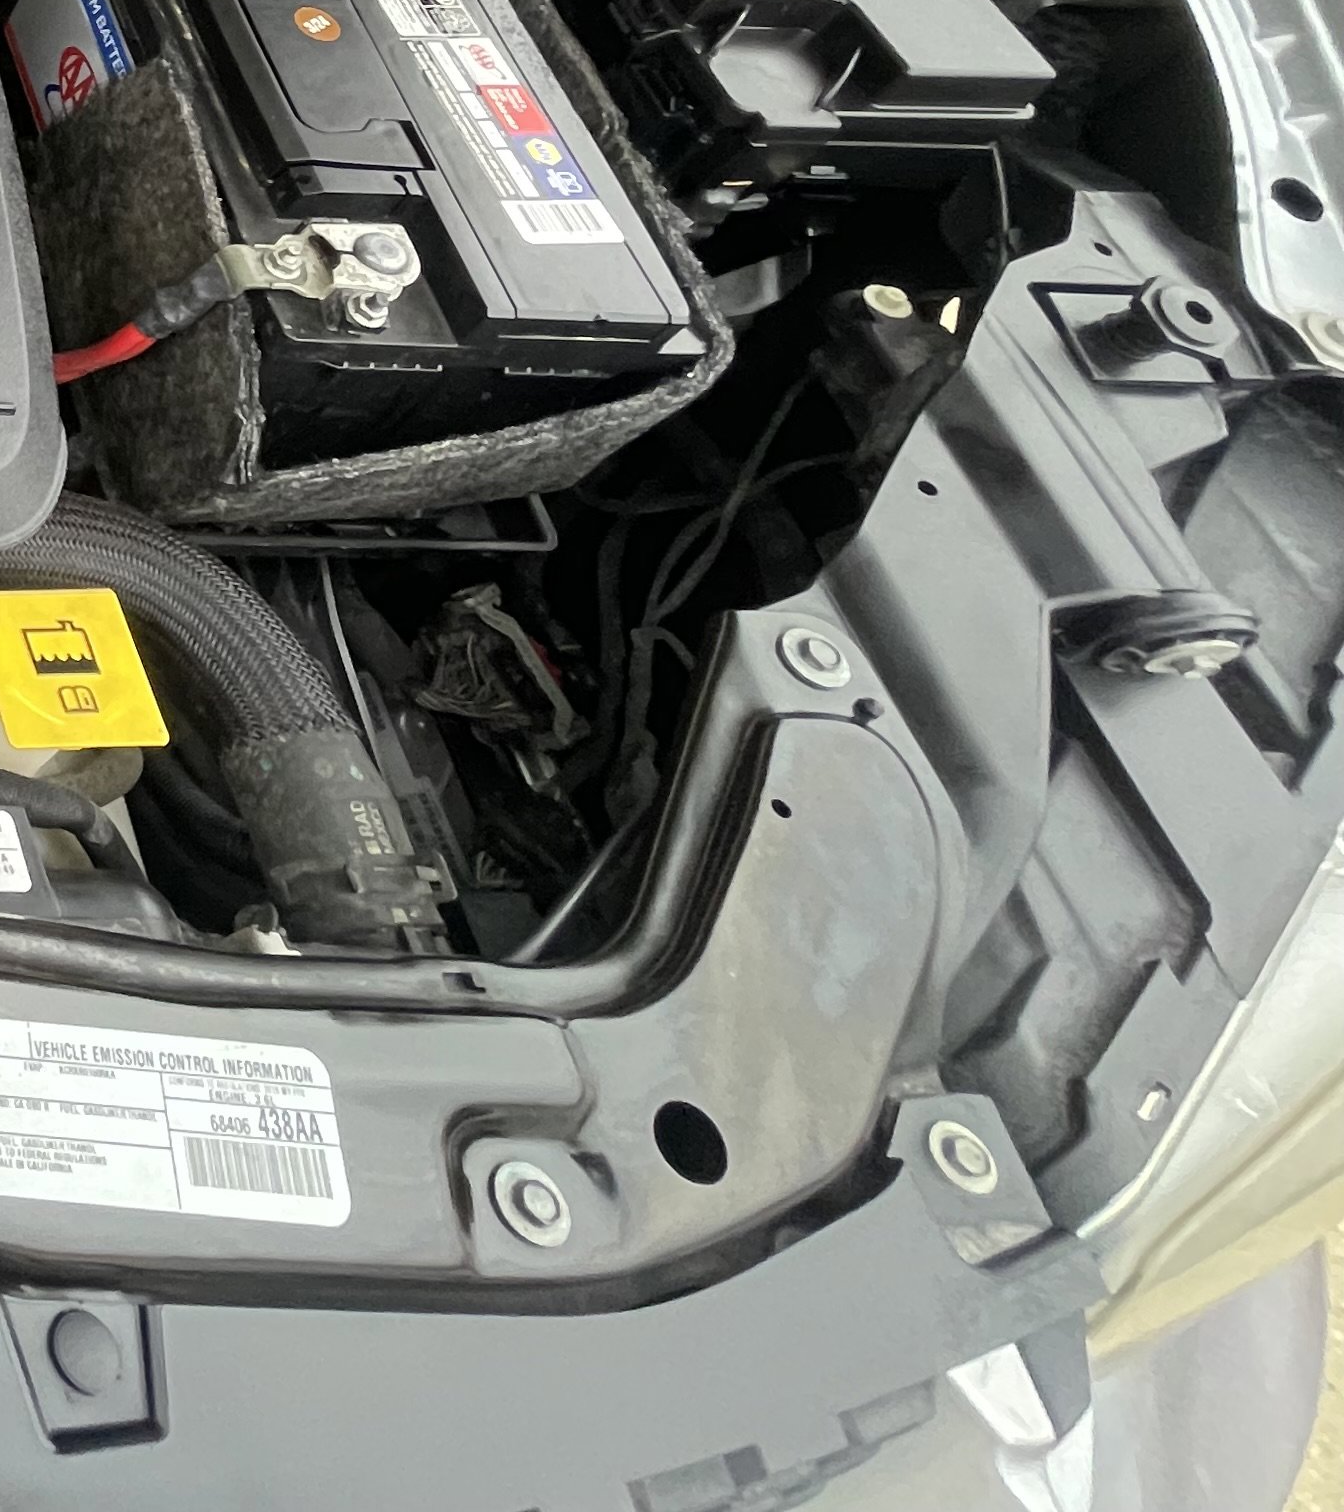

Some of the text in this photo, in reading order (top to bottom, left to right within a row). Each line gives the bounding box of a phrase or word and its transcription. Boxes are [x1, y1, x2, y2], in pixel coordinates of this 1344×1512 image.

[350, 800, 375, 837] RAD
[34, 1040, 314, 1084] VEHICLE EMISSION CONTROL INFORMATION
[210, 1107, 324, 1144] 68406 438AA
